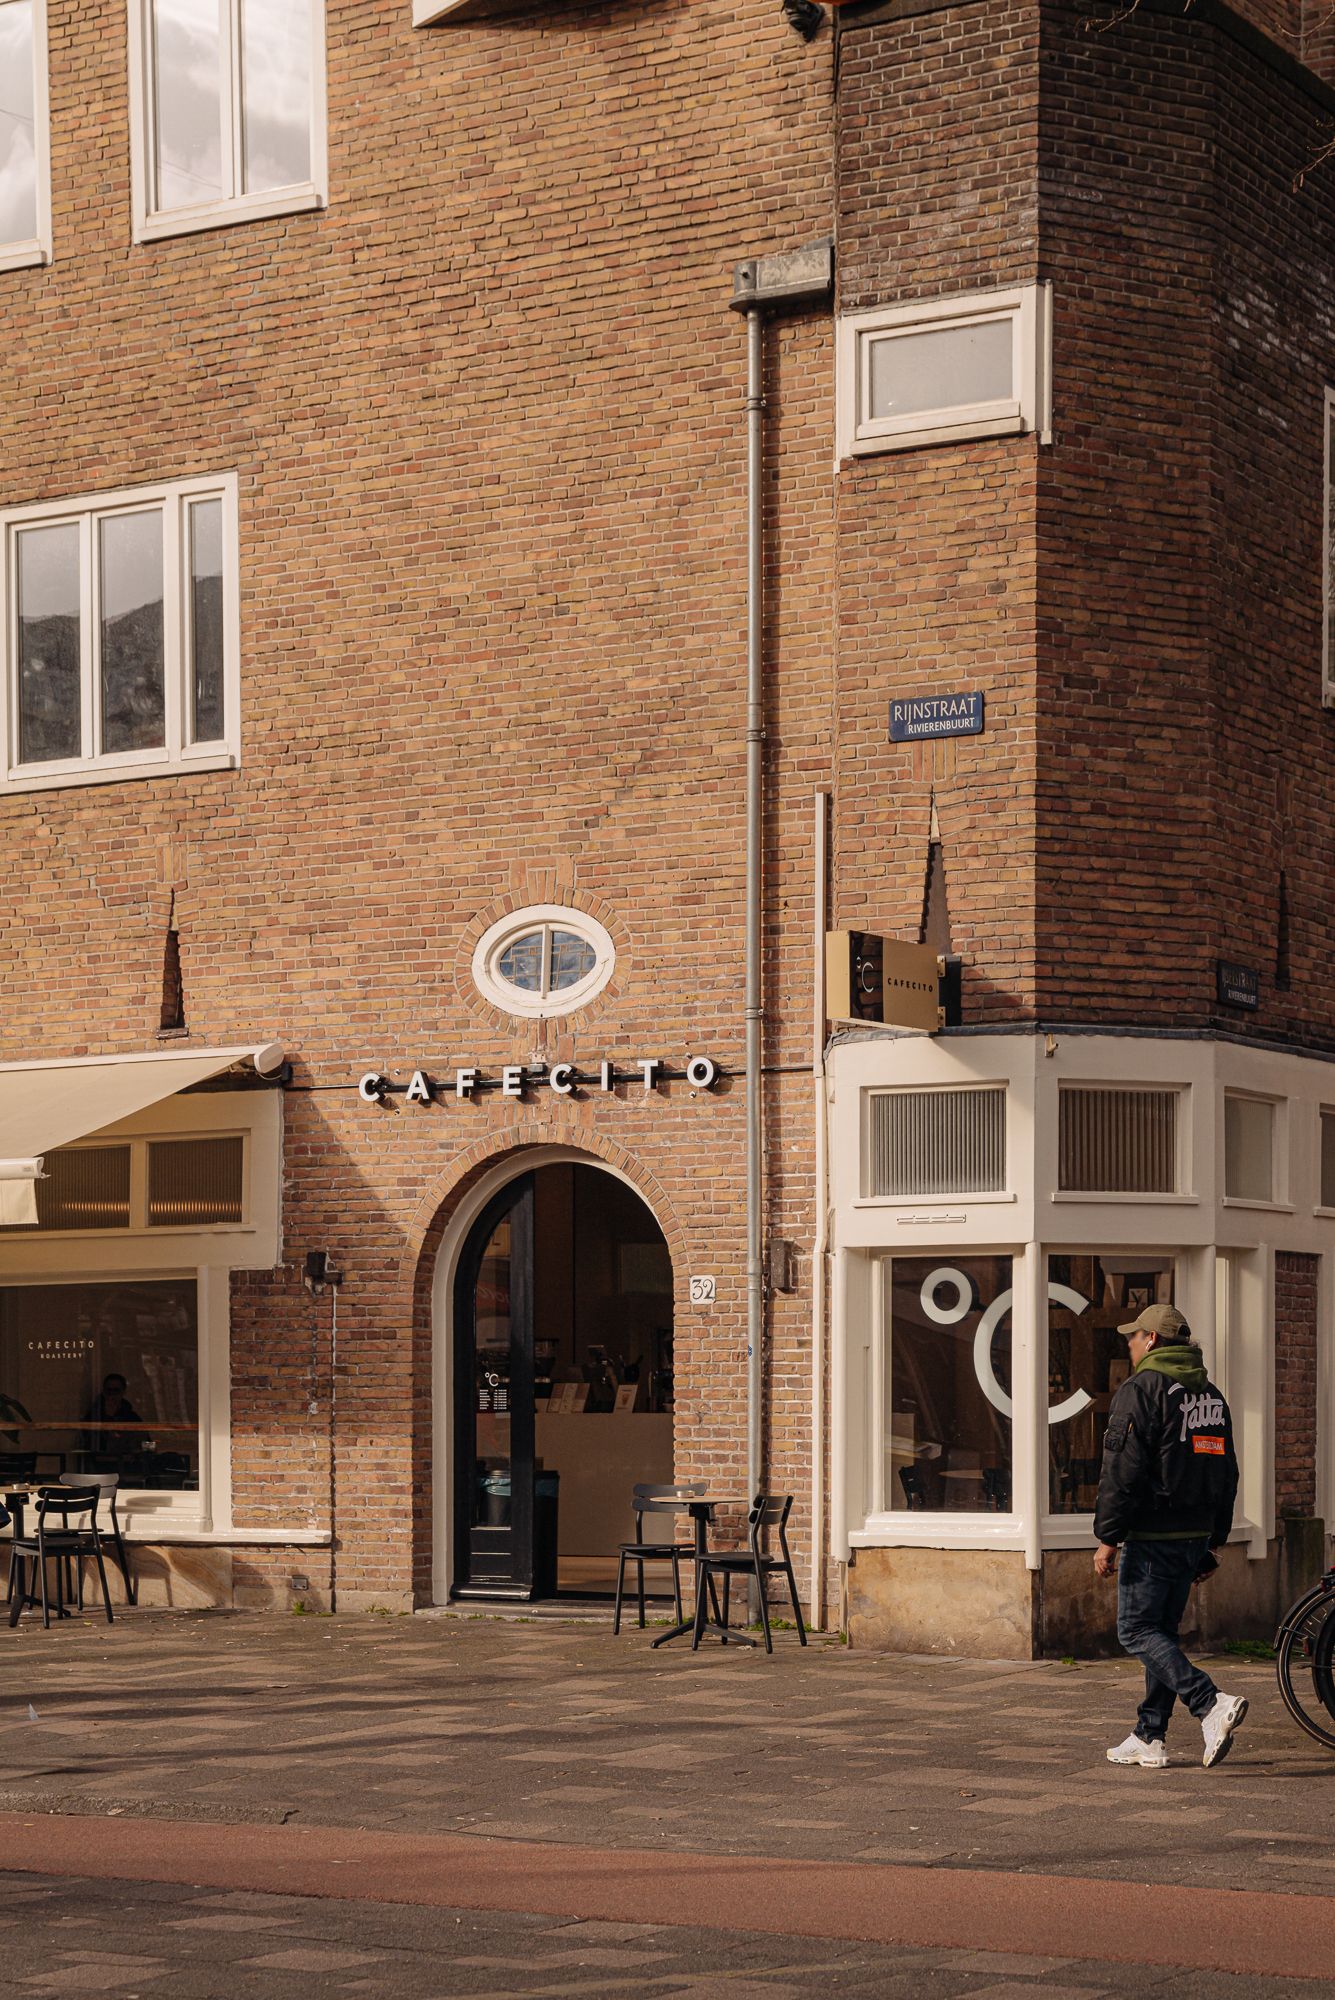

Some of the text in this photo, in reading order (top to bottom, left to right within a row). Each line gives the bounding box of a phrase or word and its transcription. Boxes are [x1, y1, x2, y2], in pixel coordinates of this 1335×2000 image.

[894, 697, 977, 725] RIJNSTRAAT
[908, 717, 975, 734] RIVIERENBUURT
[887, 977, 933, 993] CAFECITO
[358, 1056, 716, 1102] CAFECITO
[692, 1278, 715, 1300] 32
[28, 1340, 95, 1350] CAFECITO
[1168, 1382, 1226, 1442] Patta
